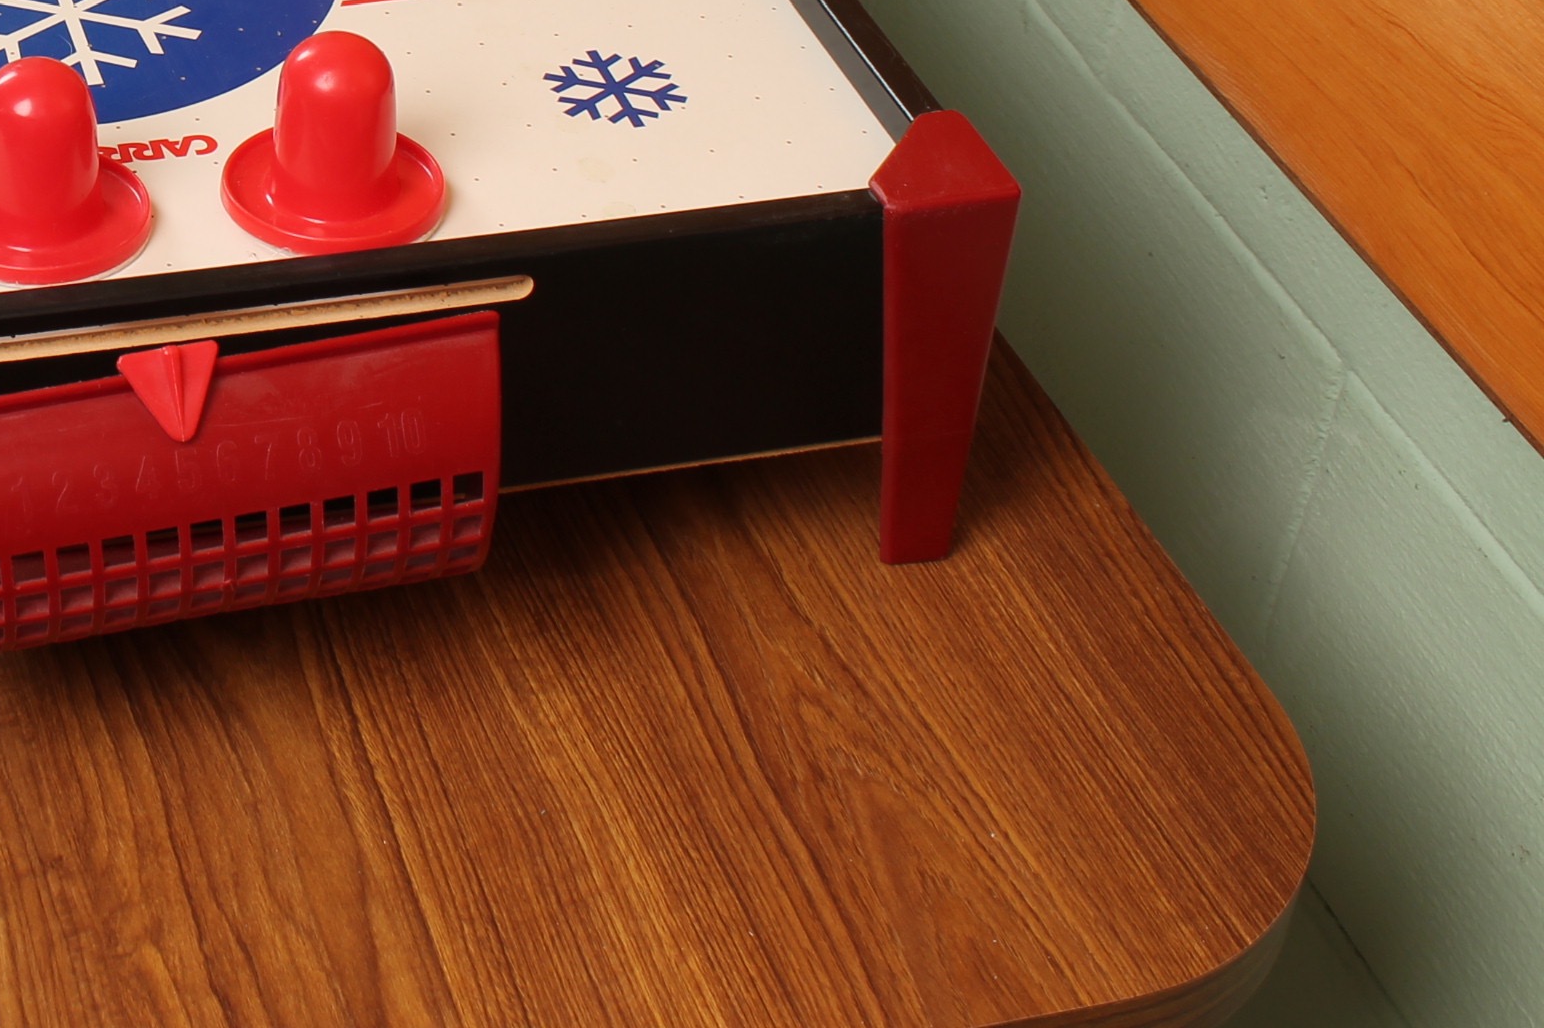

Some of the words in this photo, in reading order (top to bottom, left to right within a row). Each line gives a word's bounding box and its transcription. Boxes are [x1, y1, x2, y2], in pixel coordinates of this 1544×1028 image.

[98, 134, 218, 165] CARR
[51, 470, 79, 511] 2
[92, 463, 116, 505] 3
[174, 447, 202, 490] 5
[214, 439, 240, 485] 6
[253, 432, 279, 482] 7
[296, 426, 322, 472] 8
[335, 419, 363, 466] 9
[376, 409, 427, 461] 10
